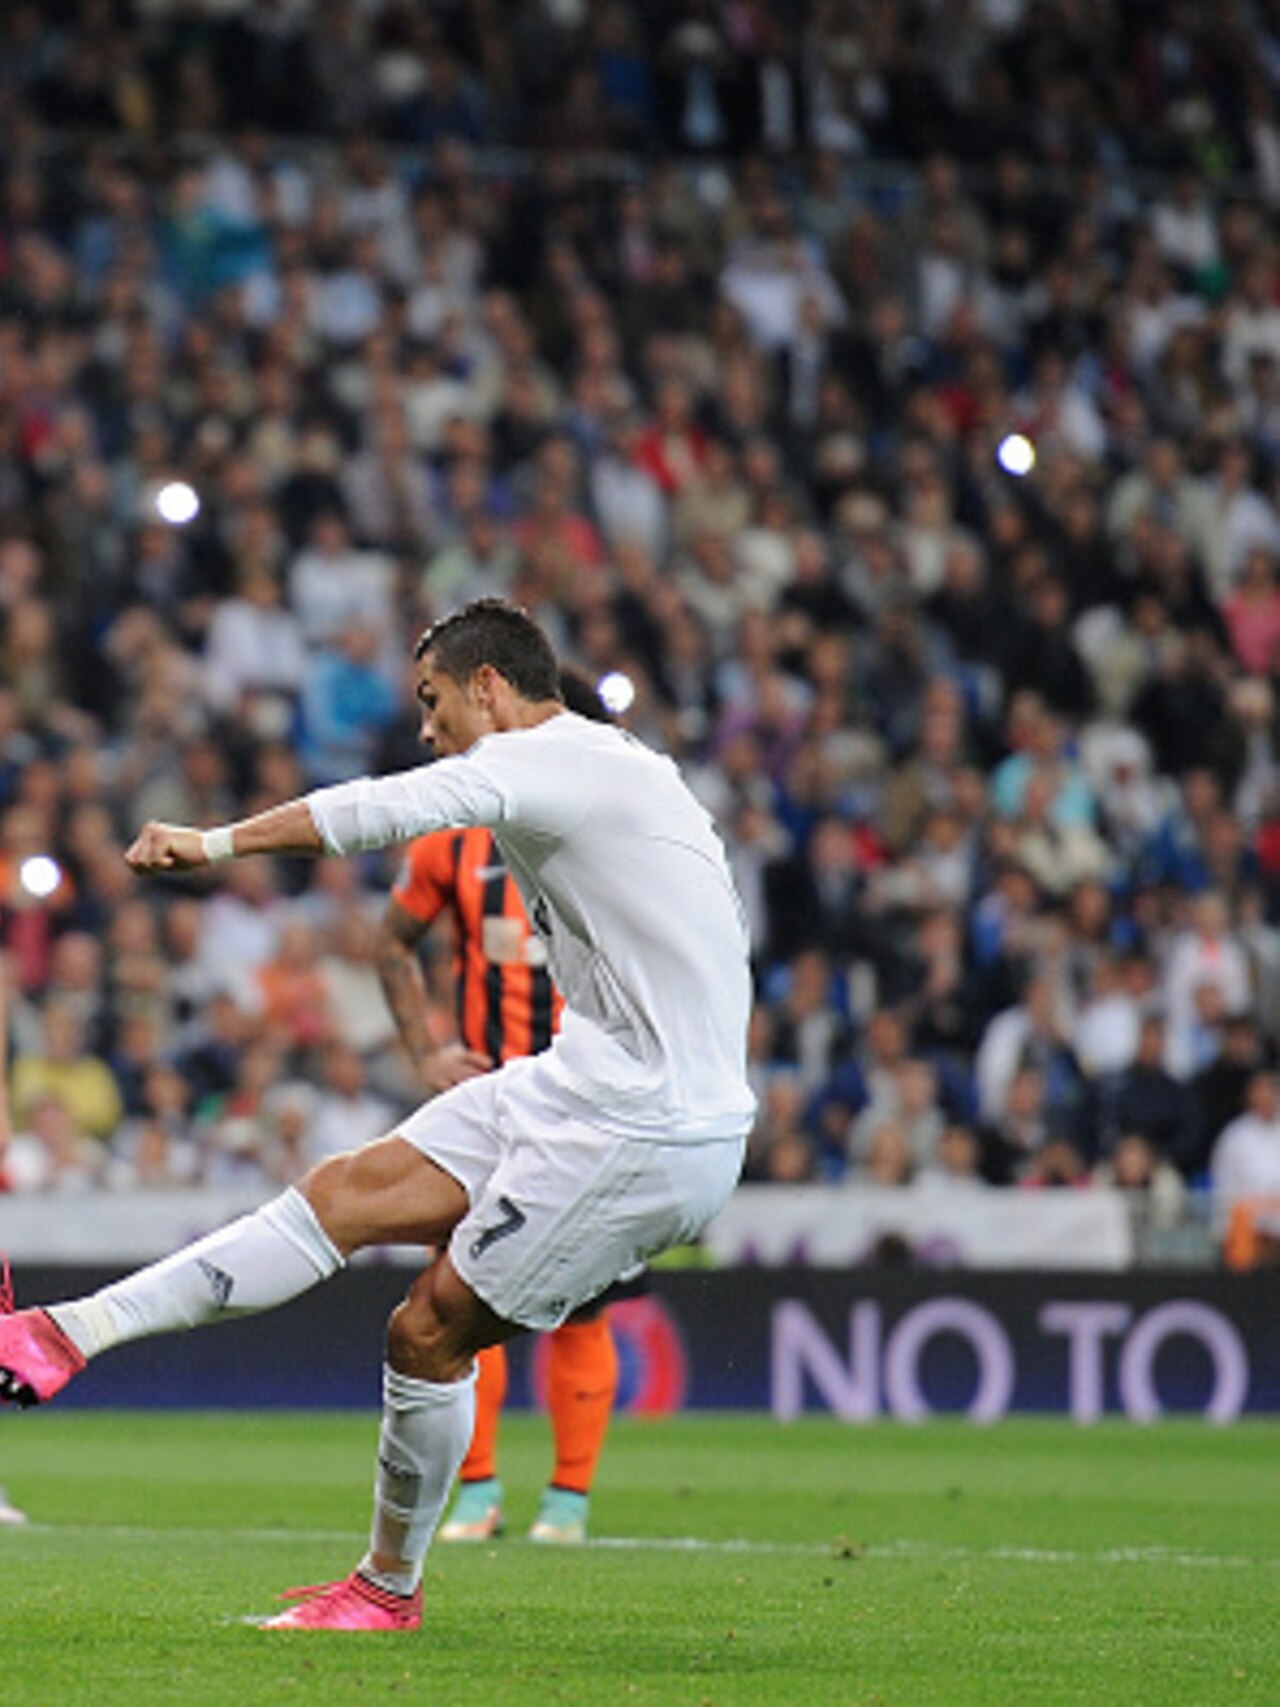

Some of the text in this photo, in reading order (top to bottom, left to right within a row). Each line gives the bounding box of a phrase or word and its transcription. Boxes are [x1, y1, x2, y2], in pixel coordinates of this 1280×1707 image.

[469, 1196, 527, 1260] 7
[770, 1298, 1249, 1425] NO TO
